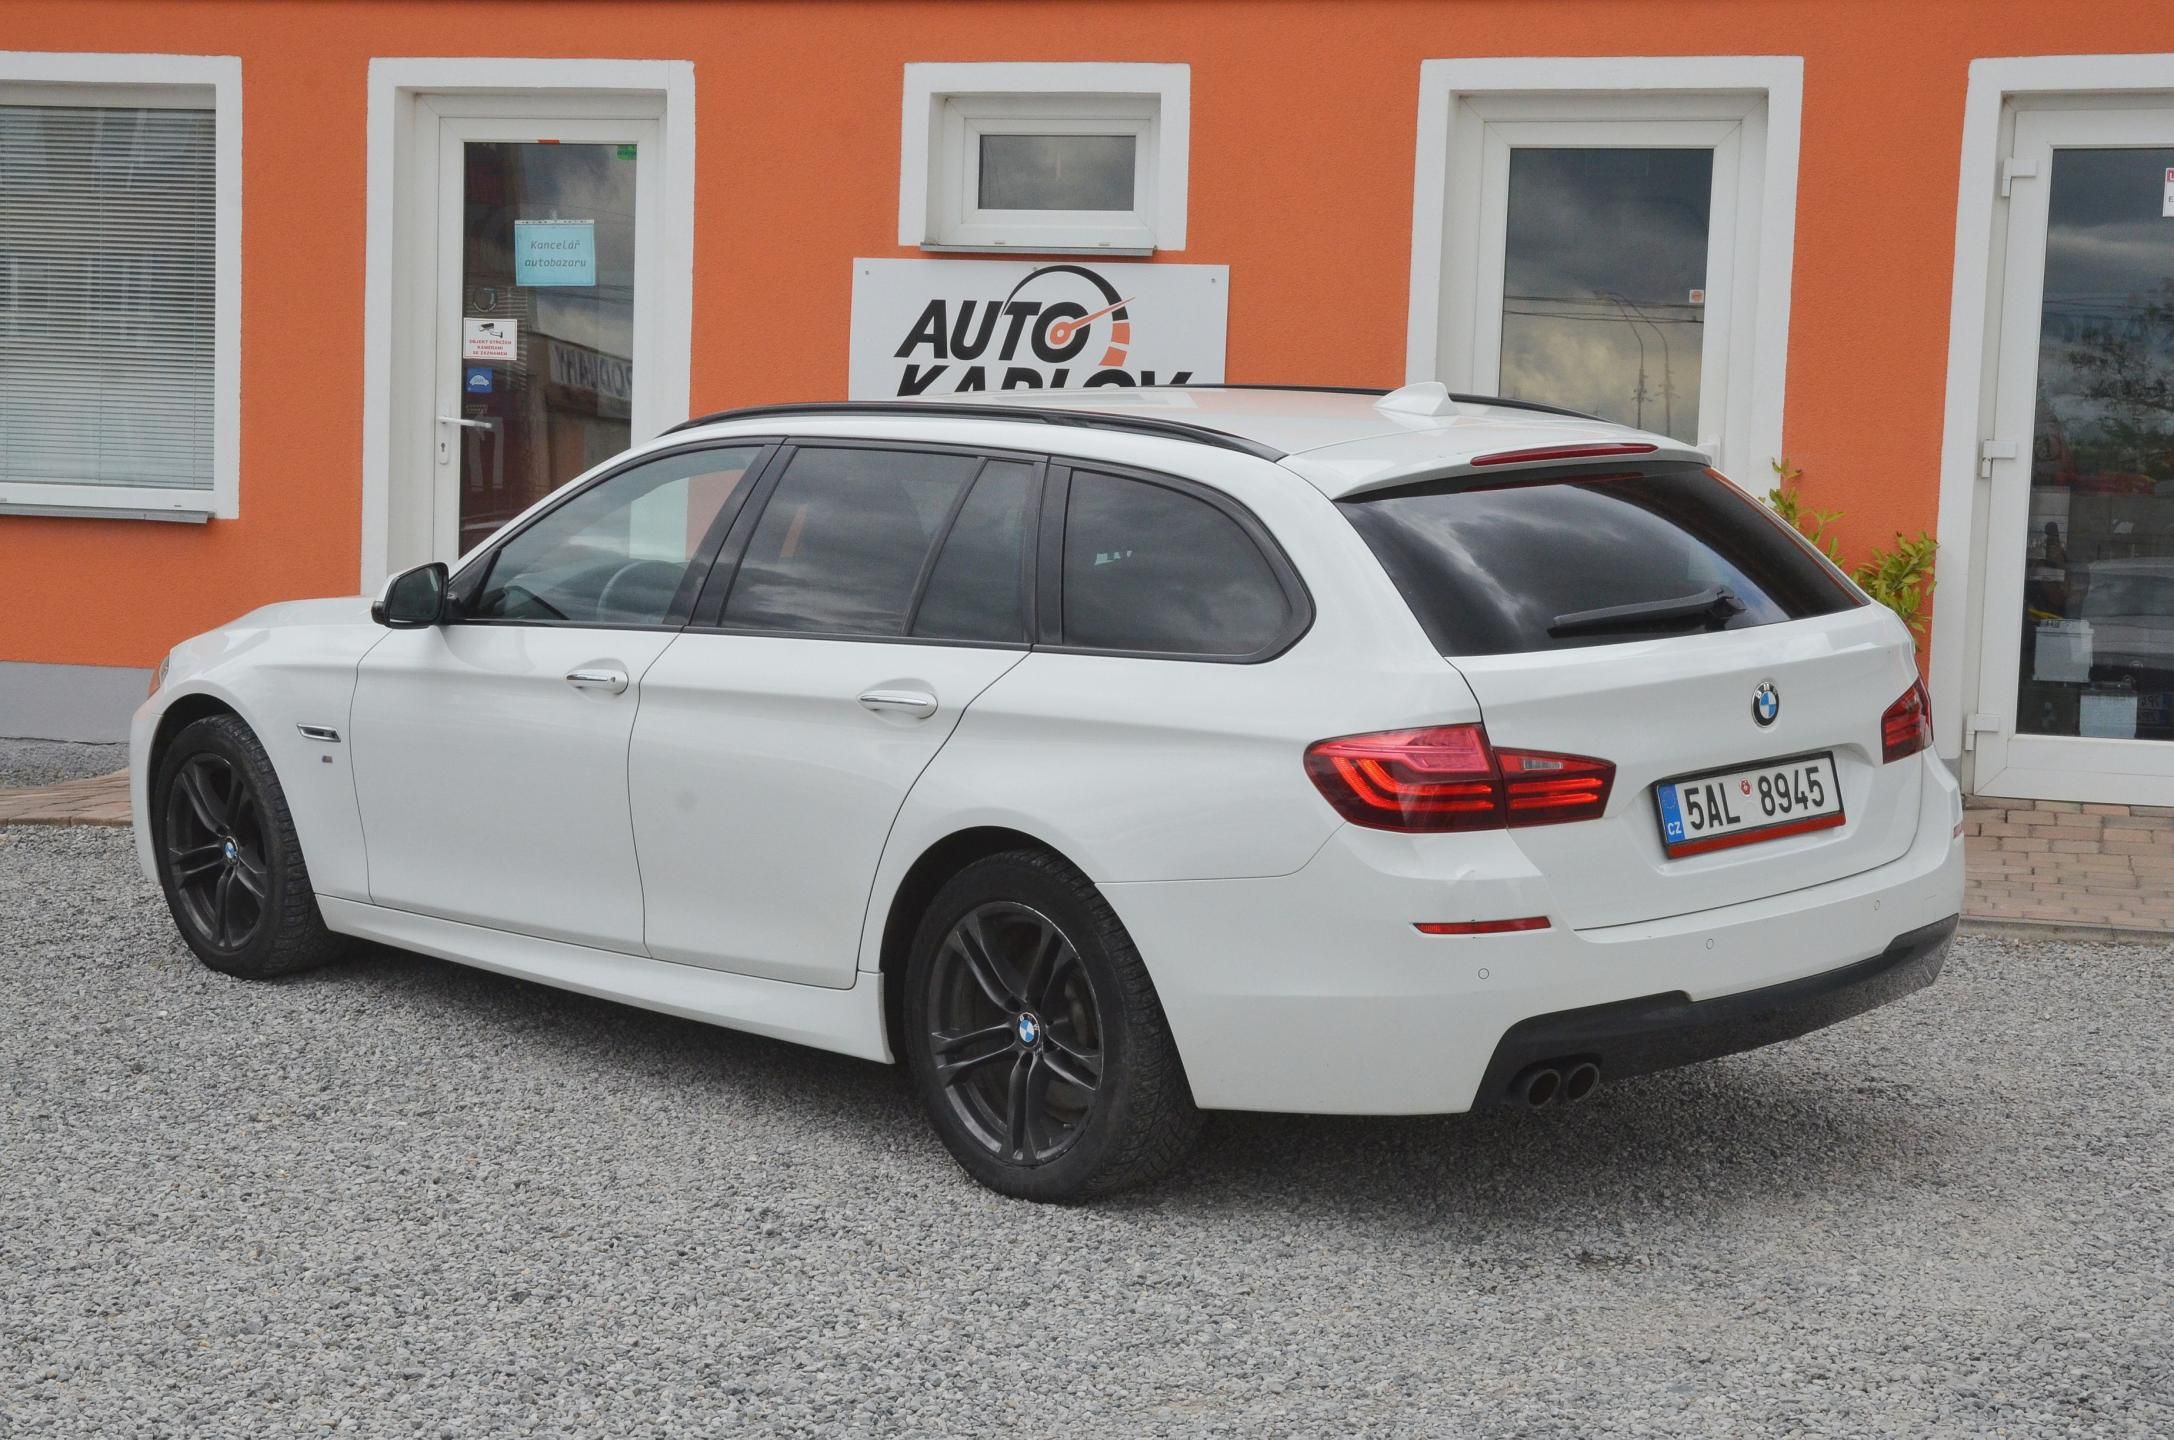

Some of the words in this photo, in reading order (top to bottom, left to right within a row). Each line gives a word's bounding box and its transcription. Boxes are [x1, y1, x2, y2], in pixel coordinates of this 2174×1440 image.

[530, 239, 581, 250] Kancelář
[524, 258, 587, 268] autobazaru
[893, 299, 1091, 363] AUTO
[1684, 782, 1741, 830] 5AL
[1757, 766, 1825, 817] 8945
[1667, 821, 1682, 835] CZ
